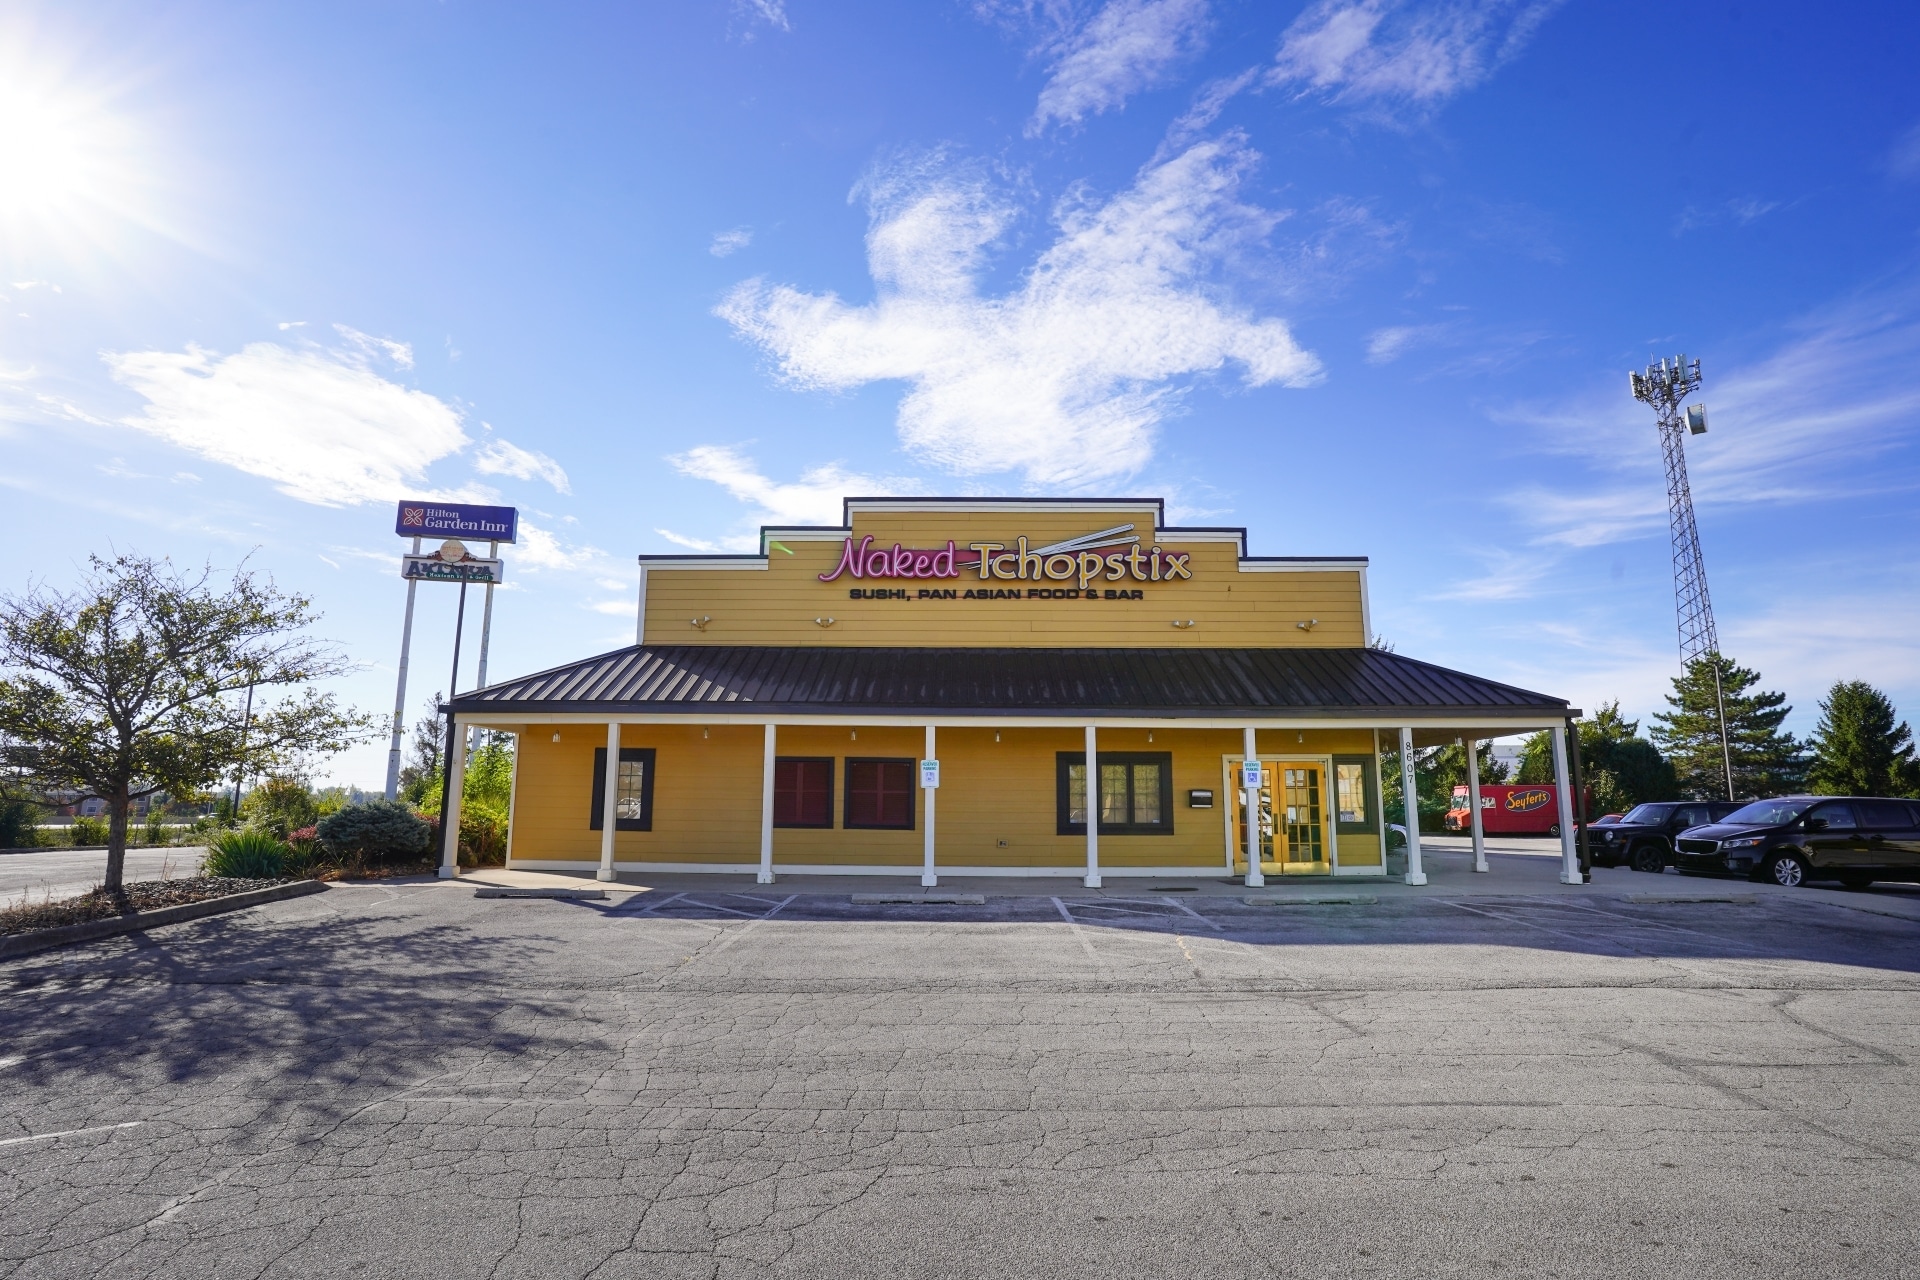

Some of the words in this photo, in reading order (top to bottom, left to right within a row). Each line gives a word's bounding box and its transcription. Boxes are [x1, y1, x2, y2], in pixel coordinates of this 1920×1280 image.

[426, 508, 459, 518] Hilton
[424, 517, 478, 530] Garden
[480, 520, 506, 532] Inn
[818, 535, 960, 582] Naked
[969, 535, 1193, 590] Tchopstix
[849, 588, 911, 601] SUSHI,
[918, 588, 957, 600] PAN
[963, 588, 1023, 600] ASIAN
[1027, 588, 1085, 600] FOOD
[1087, 588, 1099, 600] &
[1105, 589, 1144, 600] BAR
[1405, 741, 1415, 784] 8607
[1507, 791, 1547, 810] Seyfert's
